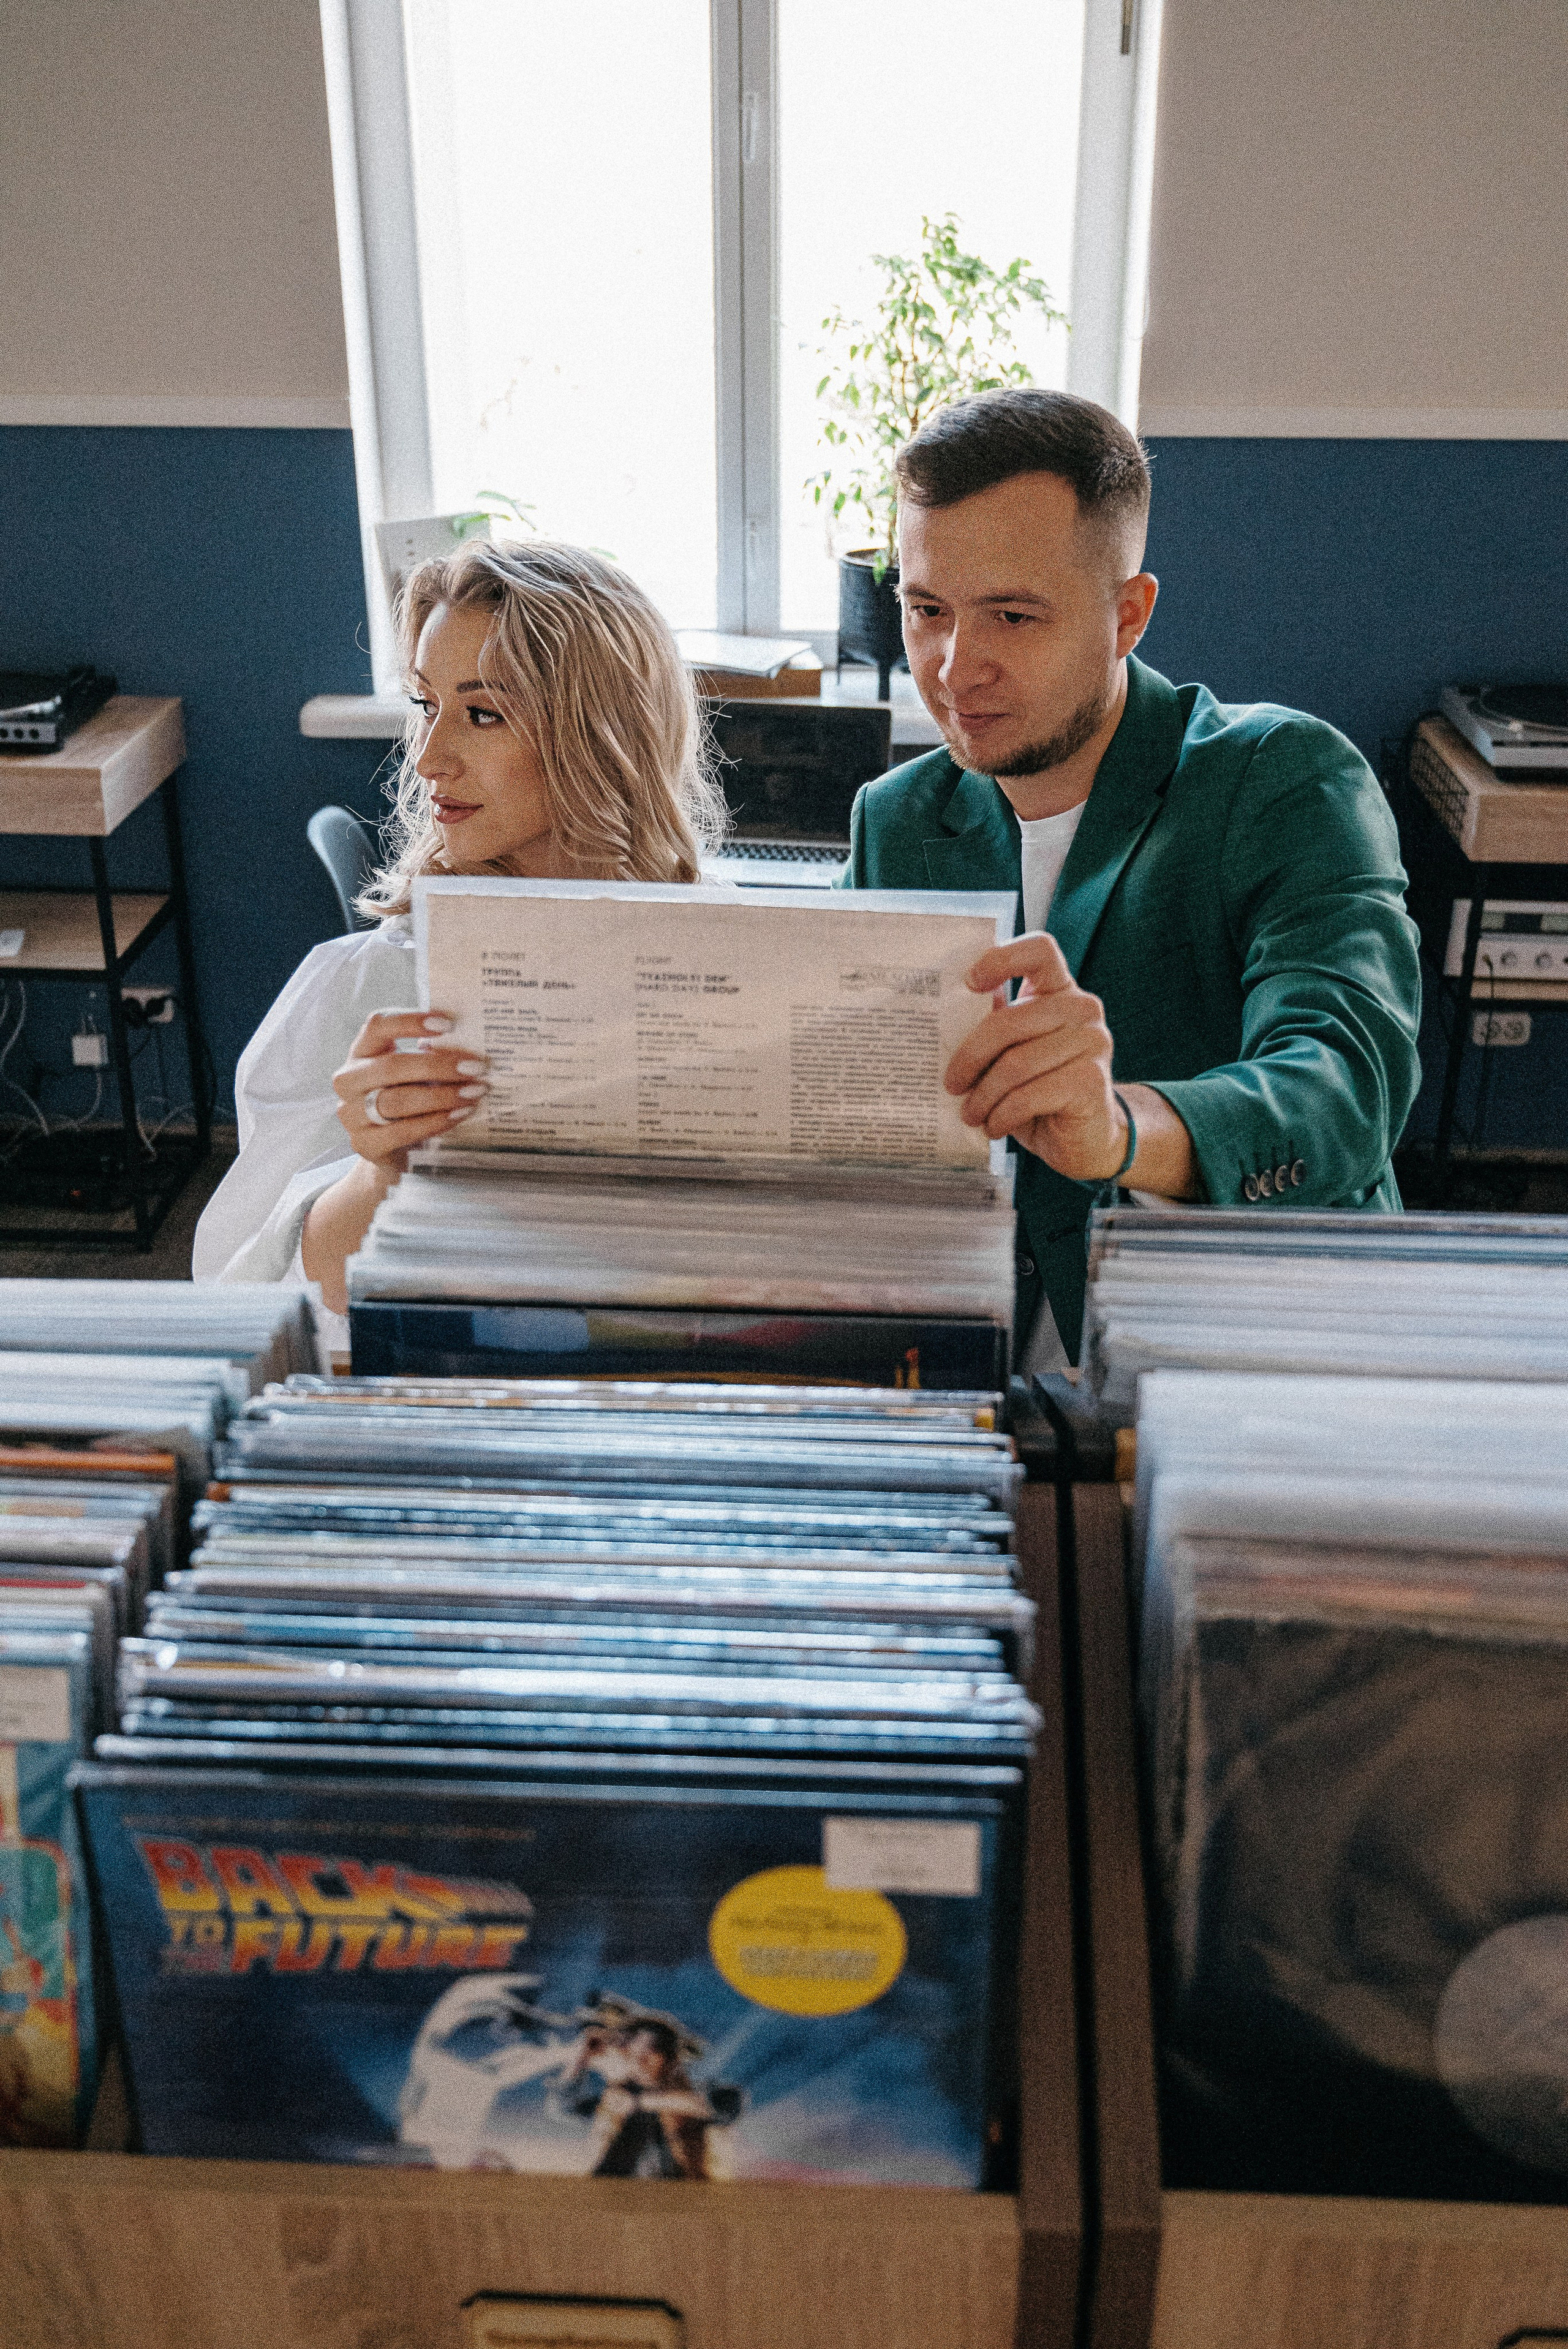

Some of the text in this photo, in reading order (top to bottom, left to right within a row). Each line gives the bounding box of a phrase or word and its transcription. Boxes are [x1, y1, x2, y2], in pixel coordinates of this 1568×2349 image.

[136, 1836, 484, 1921] BACK
[169, 1917, 225, 1945] TO
[232, 1919, 529, 1973] FUTURE
